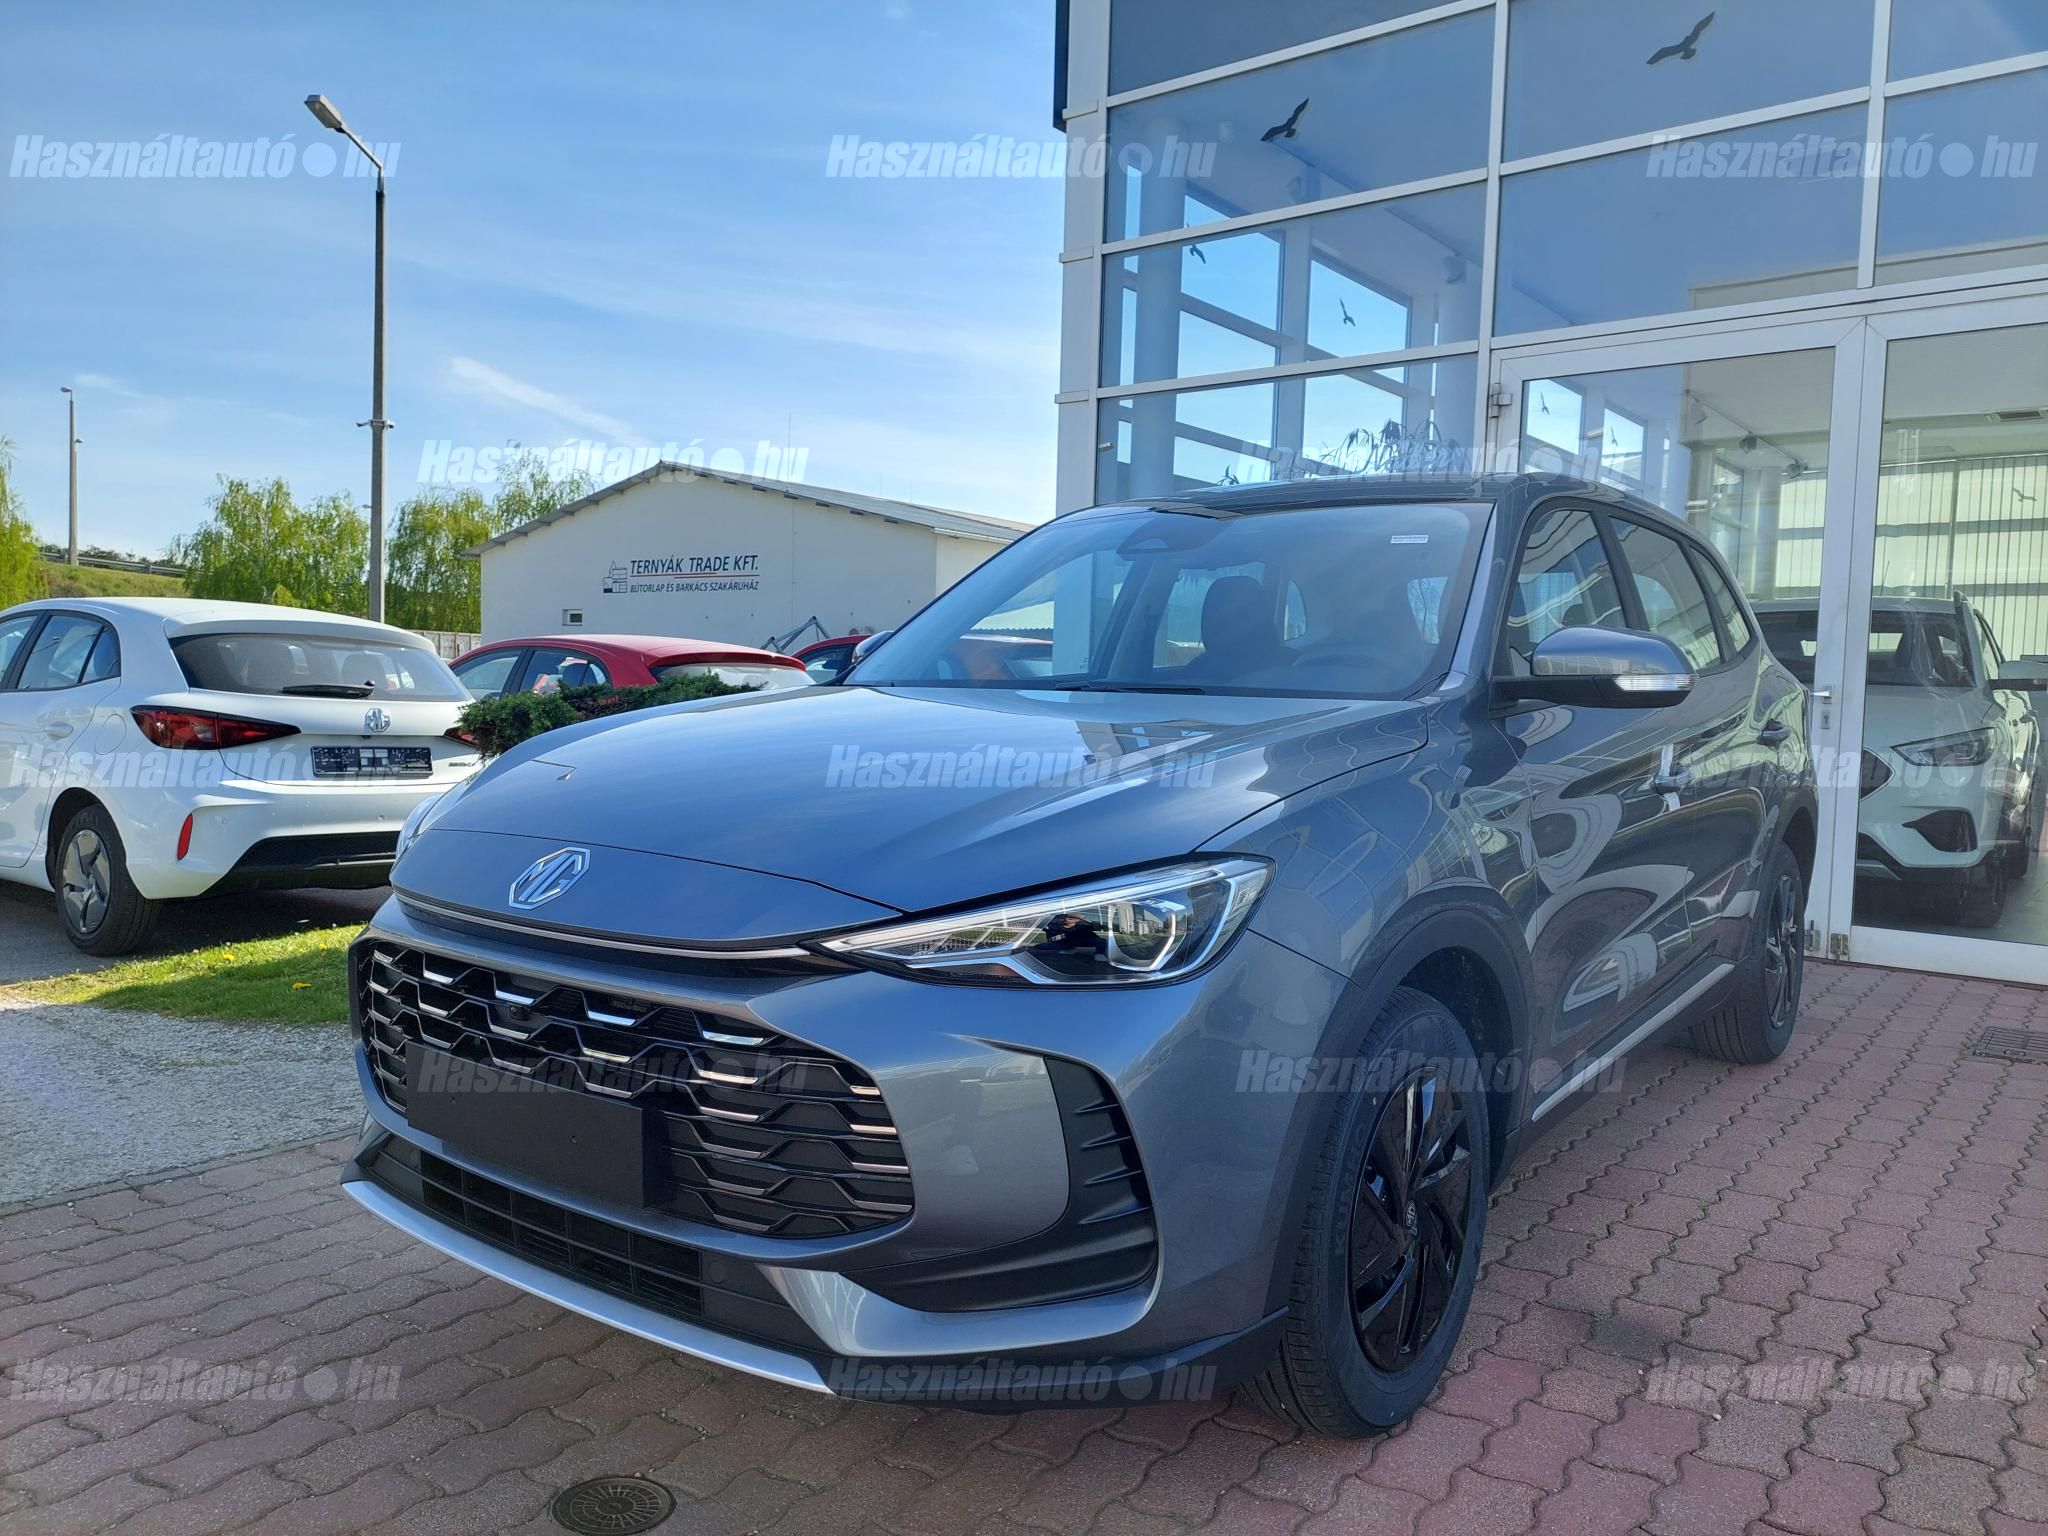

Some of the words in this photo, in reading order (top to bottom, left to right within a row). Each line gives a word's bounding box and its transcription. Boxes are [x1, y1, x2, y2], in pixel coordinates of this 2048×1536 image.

[630, 554, 684, 575] TERNYÁK
[689, 556, 731, 572] TRADE
[733, 555, 759, 571] KFT.
[675, 581, 709, 592] BARKÁCS
[710, 580, 760, 592] SZAKÁRUHÁZ
[512, 849, 589, 908] MG
